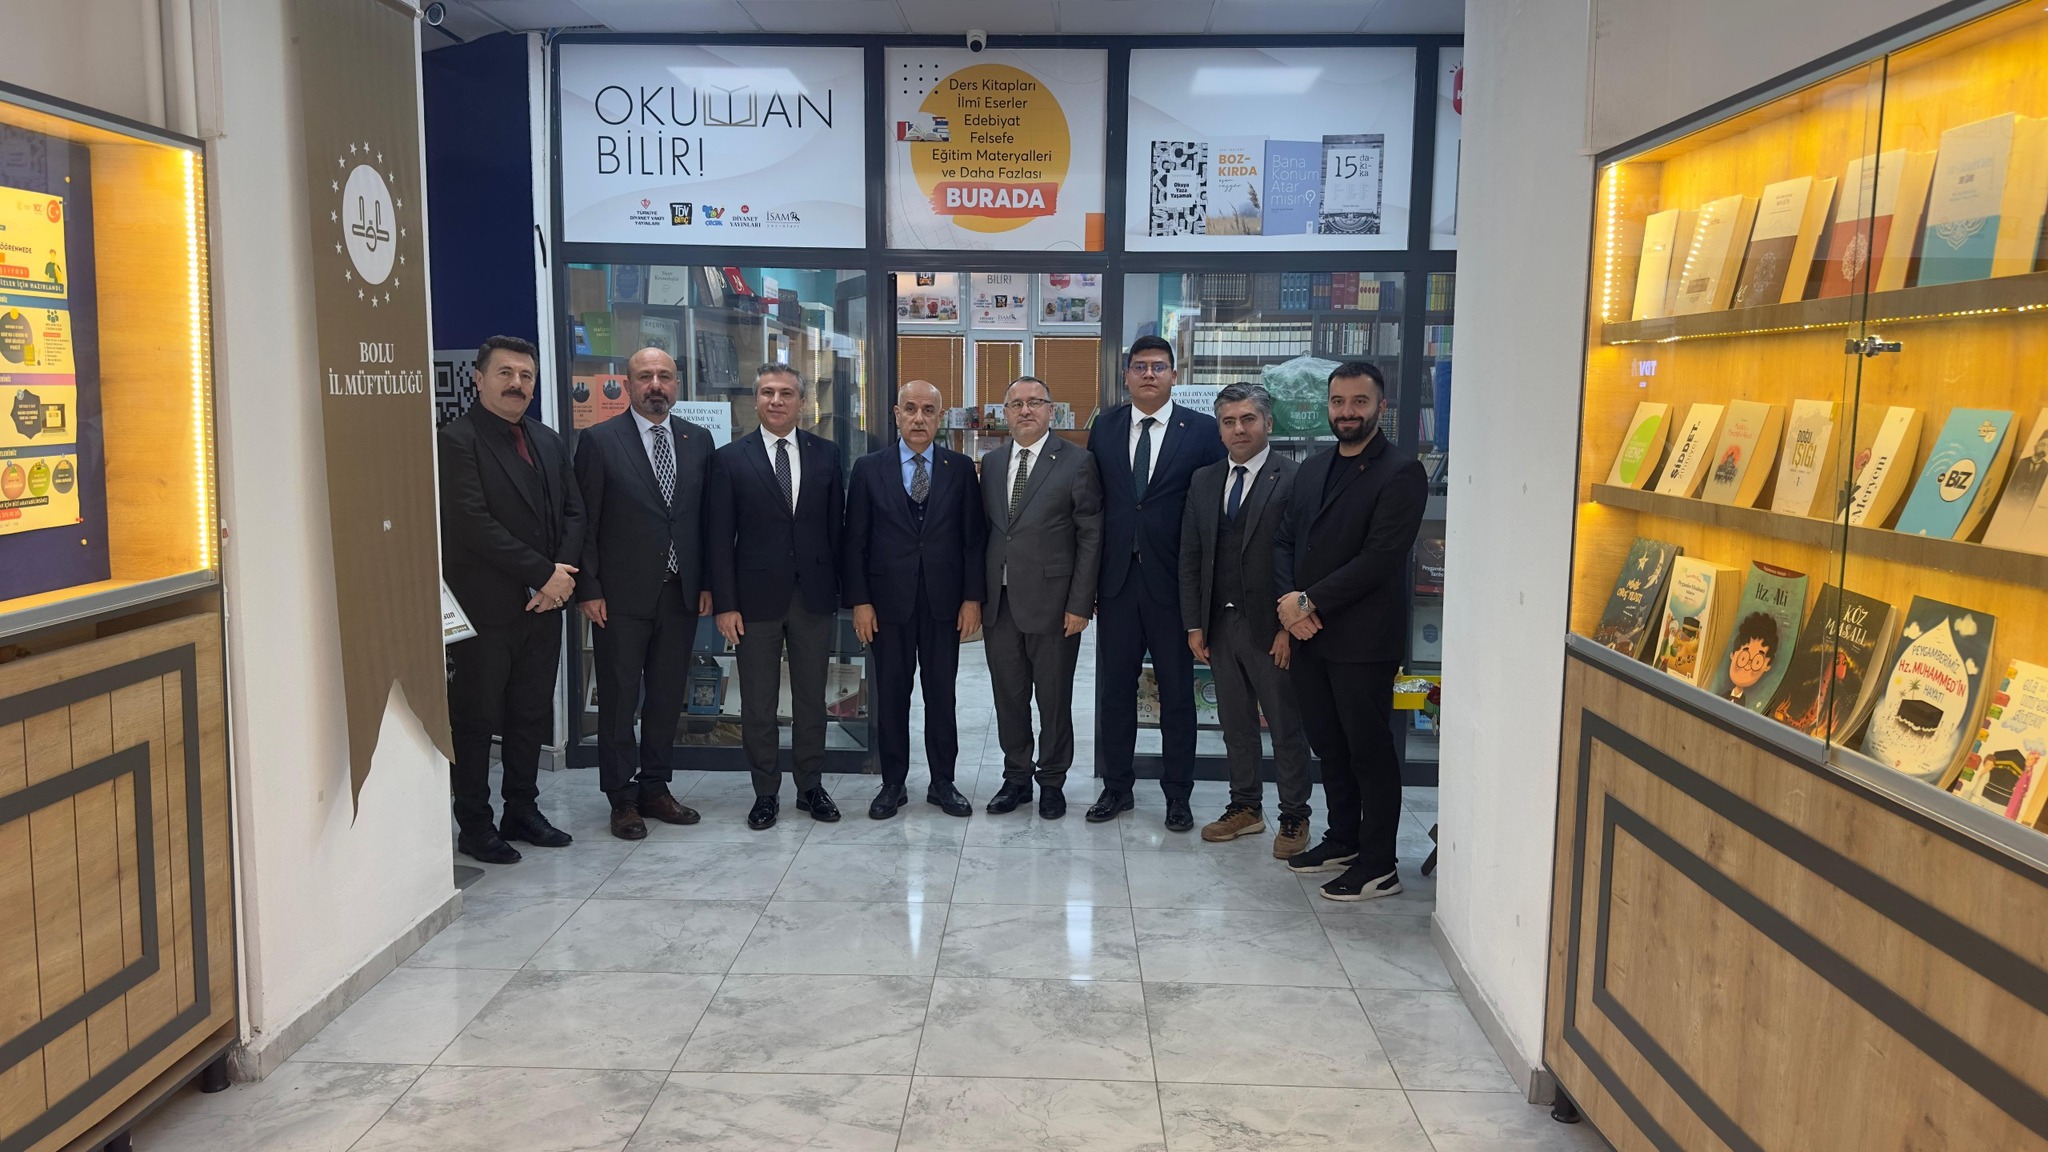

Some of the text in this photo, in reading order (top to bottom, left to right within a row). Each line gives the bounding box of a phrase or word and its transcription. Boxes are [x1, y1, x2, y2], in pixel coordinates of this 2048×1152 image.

[949, 79, 1036, 93] Ders Kitapları
[957, 94, 1028, 109] İlmî Eserler
[965, 114, 1021, 129] Edebiyat
[971, 132, 1015, 144] Felsefe
[598, 130, 704, 177] BİLİR!
[932, 149, 1052, 164] Eğitim Materyalleri
[1272, 154, 1306, 168] Bana
[942, 167, 1042, 179] ve Daha Fazlası
[1218, 166, 1258, 177] KIRDA
[1272, 168, 1319, 181] Konum
[1335, 155, 1358, 179] 15
[1271, 180, 1300, 193] Atar
[946, 187, 1046, 209] BURADA
[672, 205, 690, 217] TDV
[359, 341, 395, 364] BOLU
[329, 367, 423, 395] İL MÜFTÜLÜĞÜ
[1852, 455, 1888, 518] Meryem
[1843, 604, 1869, 626] KÖZ
[1911, 645, 1961, 675] PEYGAMBERİMİZ
[1922, 684, 1945, 703] HAYATI
